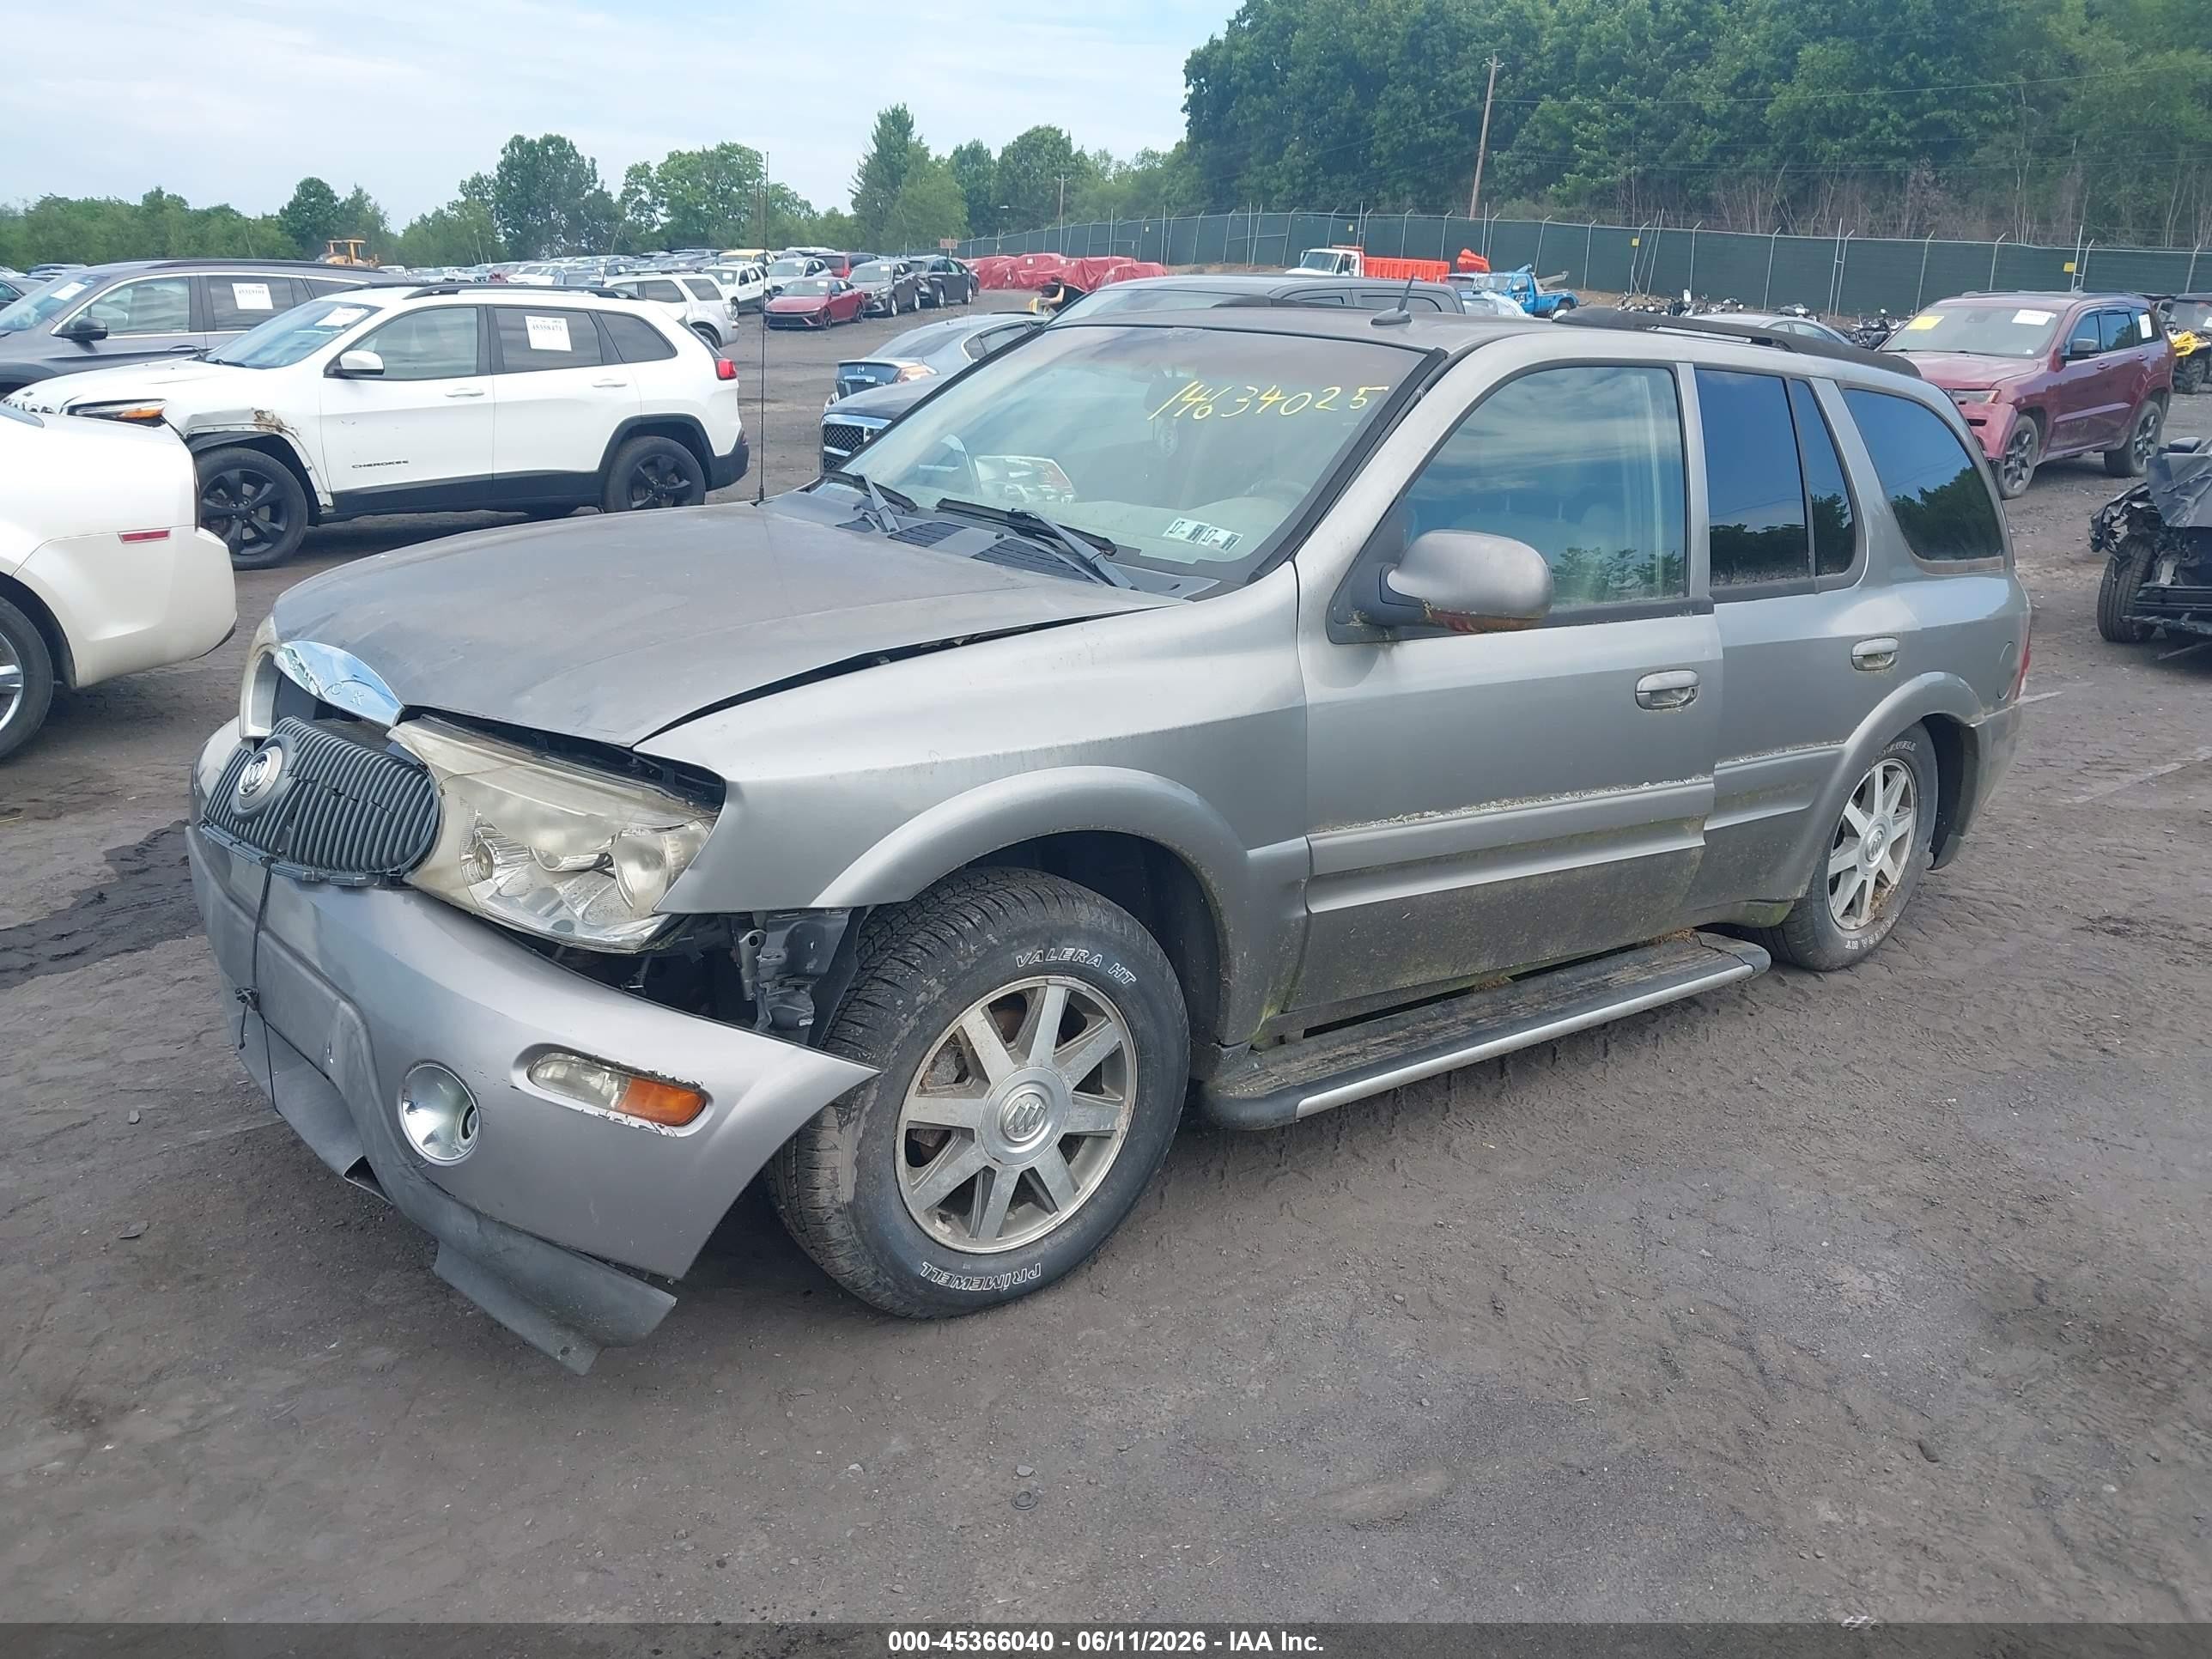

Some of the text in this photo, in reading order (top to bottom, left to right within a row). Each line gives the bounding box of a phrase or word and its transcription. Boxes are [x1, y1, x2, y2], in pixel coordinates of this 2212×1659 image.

[1147, 380, 1389, 420] 14634025
[289, 658, 364, 706] BUICK
[1016, 948, 1137, 985] VALERA HT
[920, 1261, 1042, 1291] PRIMEWELL
